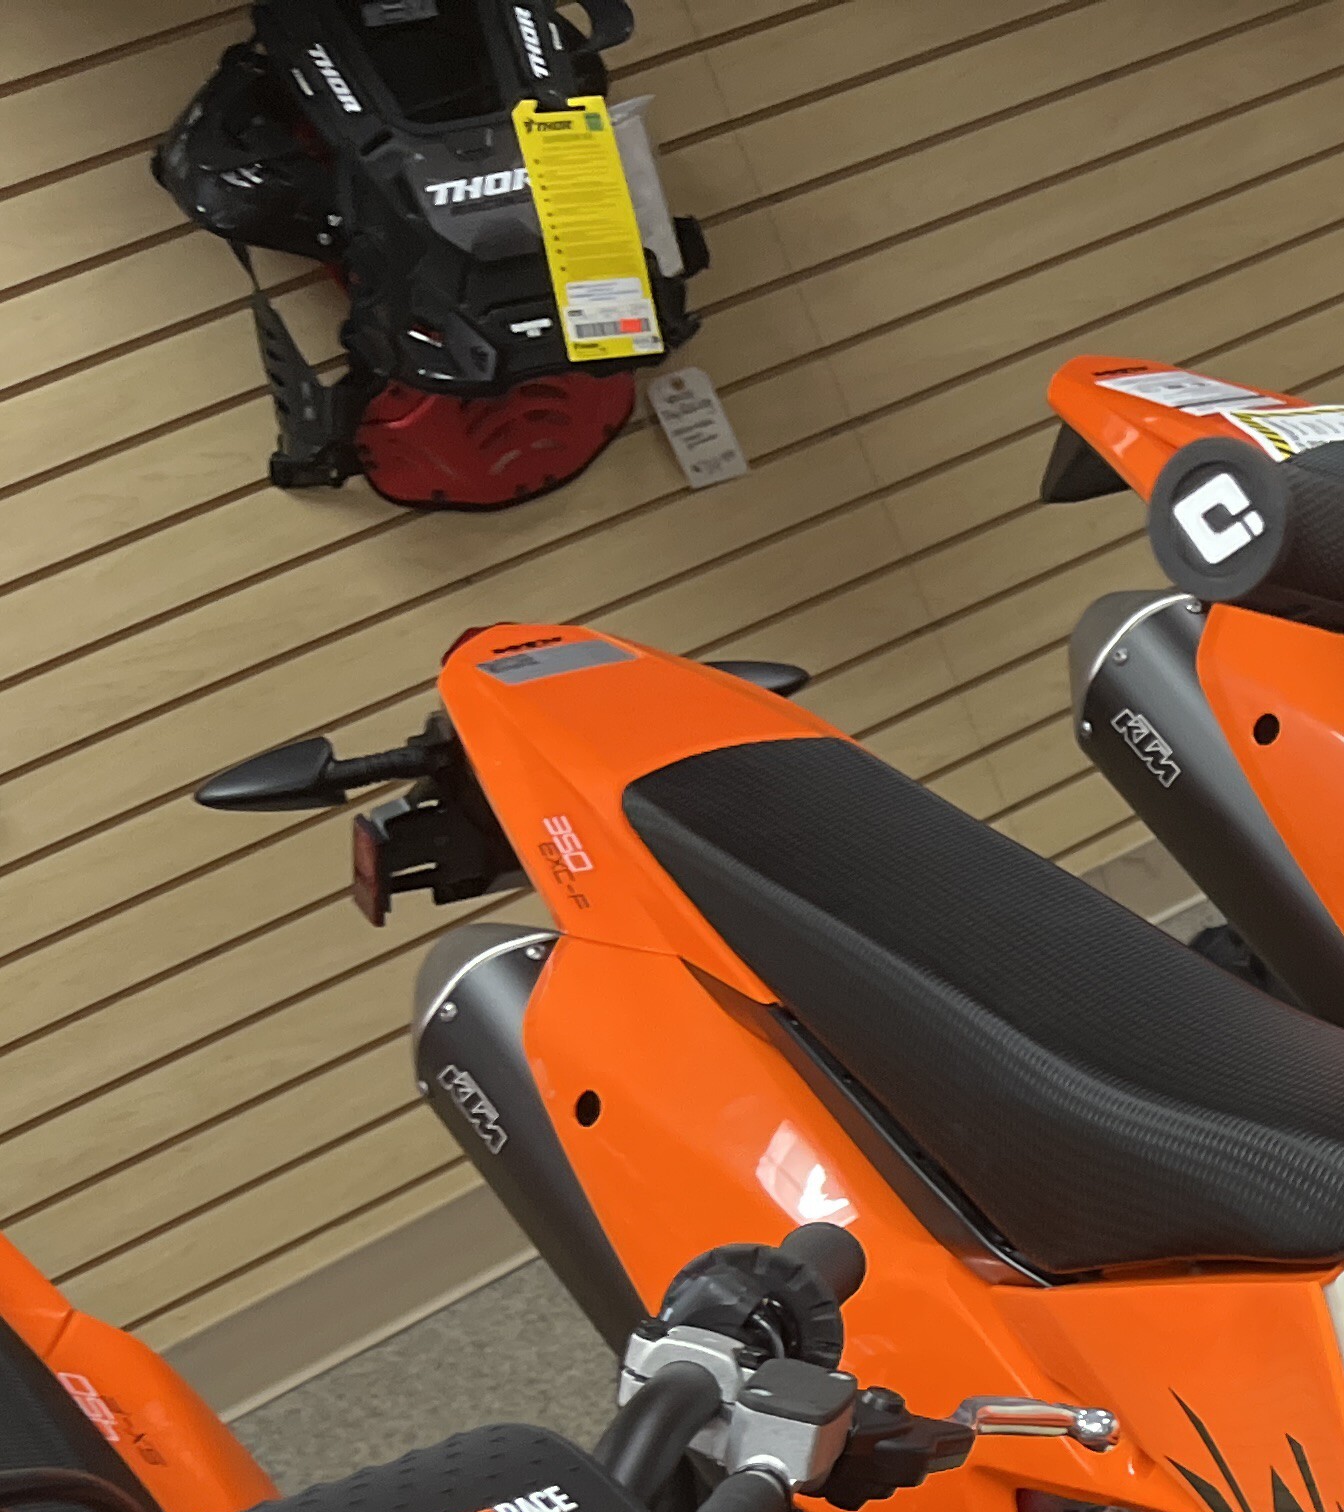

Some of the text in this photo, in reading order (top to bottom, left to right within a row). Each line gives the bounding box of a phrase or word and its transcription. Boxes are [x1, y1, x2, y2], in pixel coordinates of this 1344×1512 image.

[513, 5, 549, 78] THOR
[308, 43, 362, 112] THOR
[1110, 708, 1181, 788] KTM
[538, 842, 590, 909] EXC-F
[542, 815, 593, 873] 350
[437, 1064, 508, 1155] KTM
